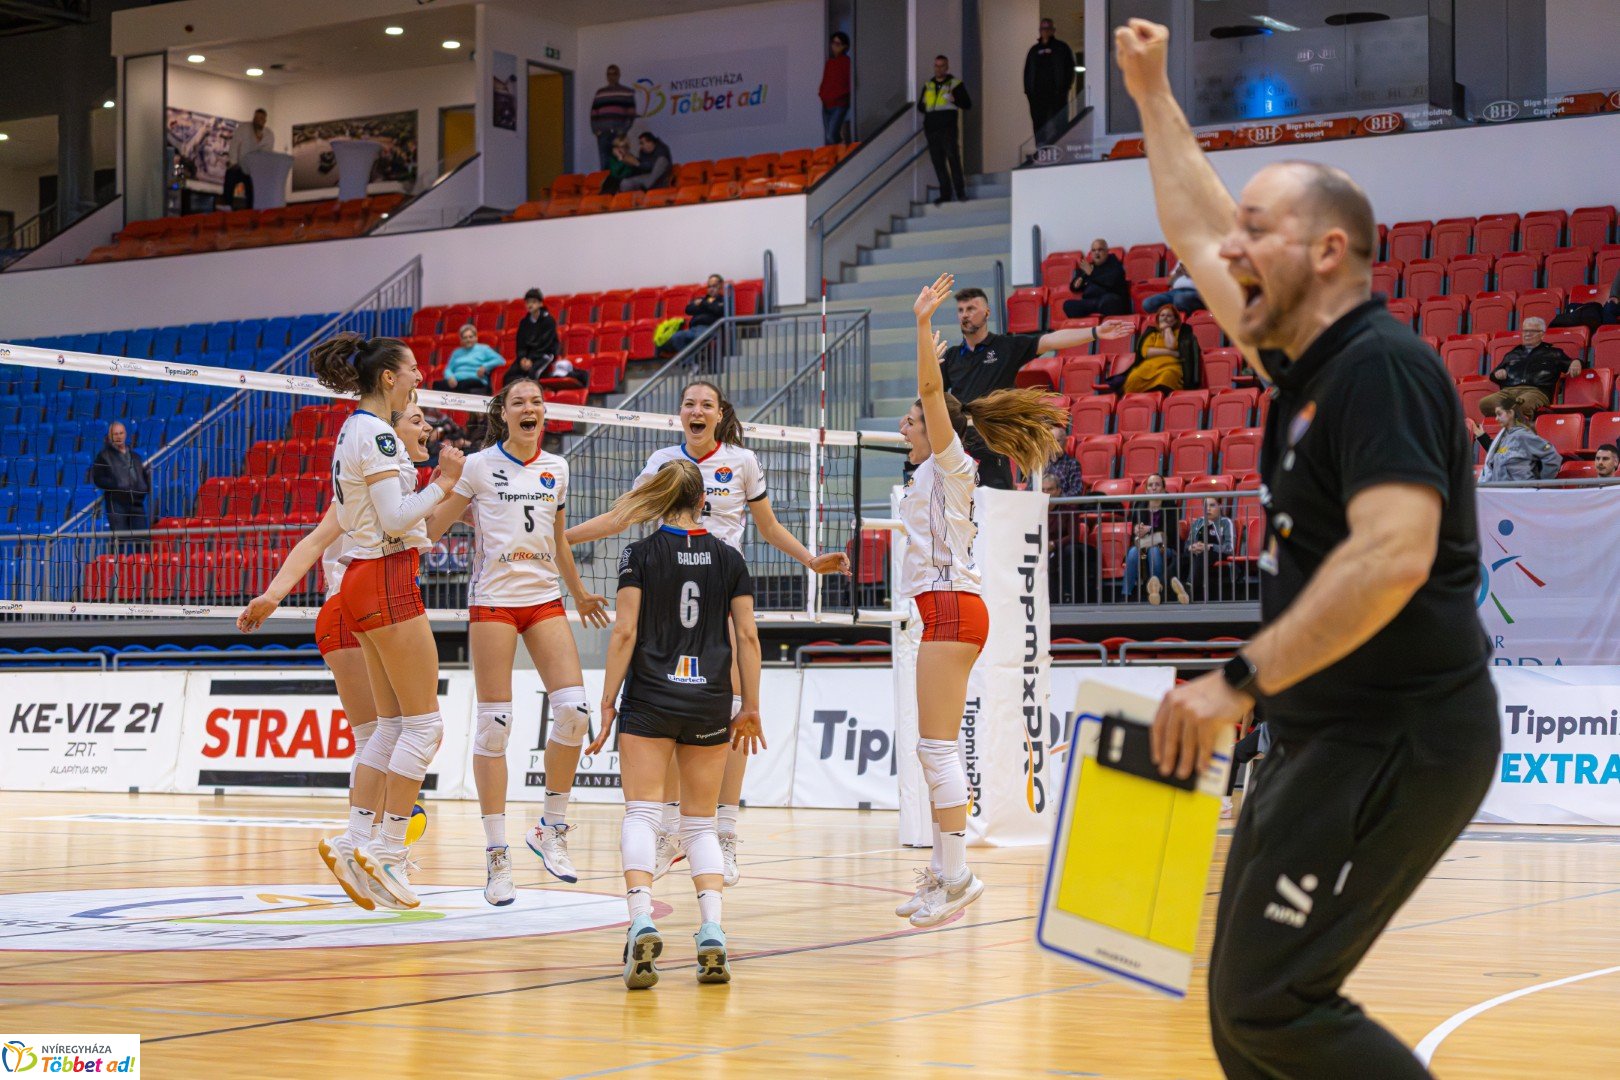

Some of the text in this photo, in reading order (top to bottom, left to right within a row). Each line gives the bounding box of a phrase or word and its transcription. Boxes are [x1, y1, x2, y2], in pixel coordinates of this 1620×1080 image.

[670, 84, 768, 115] Többet ad!
[1489, 104, 1513, 118] BH
[1255, 127, 1277, 141] BH
[1371, 116, 1394, 130] BH
[164, 366, 199, 377] TippmixPRO
[497, 491, 555, 503] TippmixPRO
[523, 505, 535, 533] 5
[677, 551, 712, 565] BALOGH
[679, 580, 701, 629] 6
[1018, 524, 1046, 815] TippmixPRO
[9, 702, 164, 733] KE-VIZ 21
[1505, 705, 1620, 744] Tippmi
[64, 742, 98, 757] ZRT.
[961, 696, 982, 818] TippmixPRO
[1501, 753, 1620, 785] EXTRA
